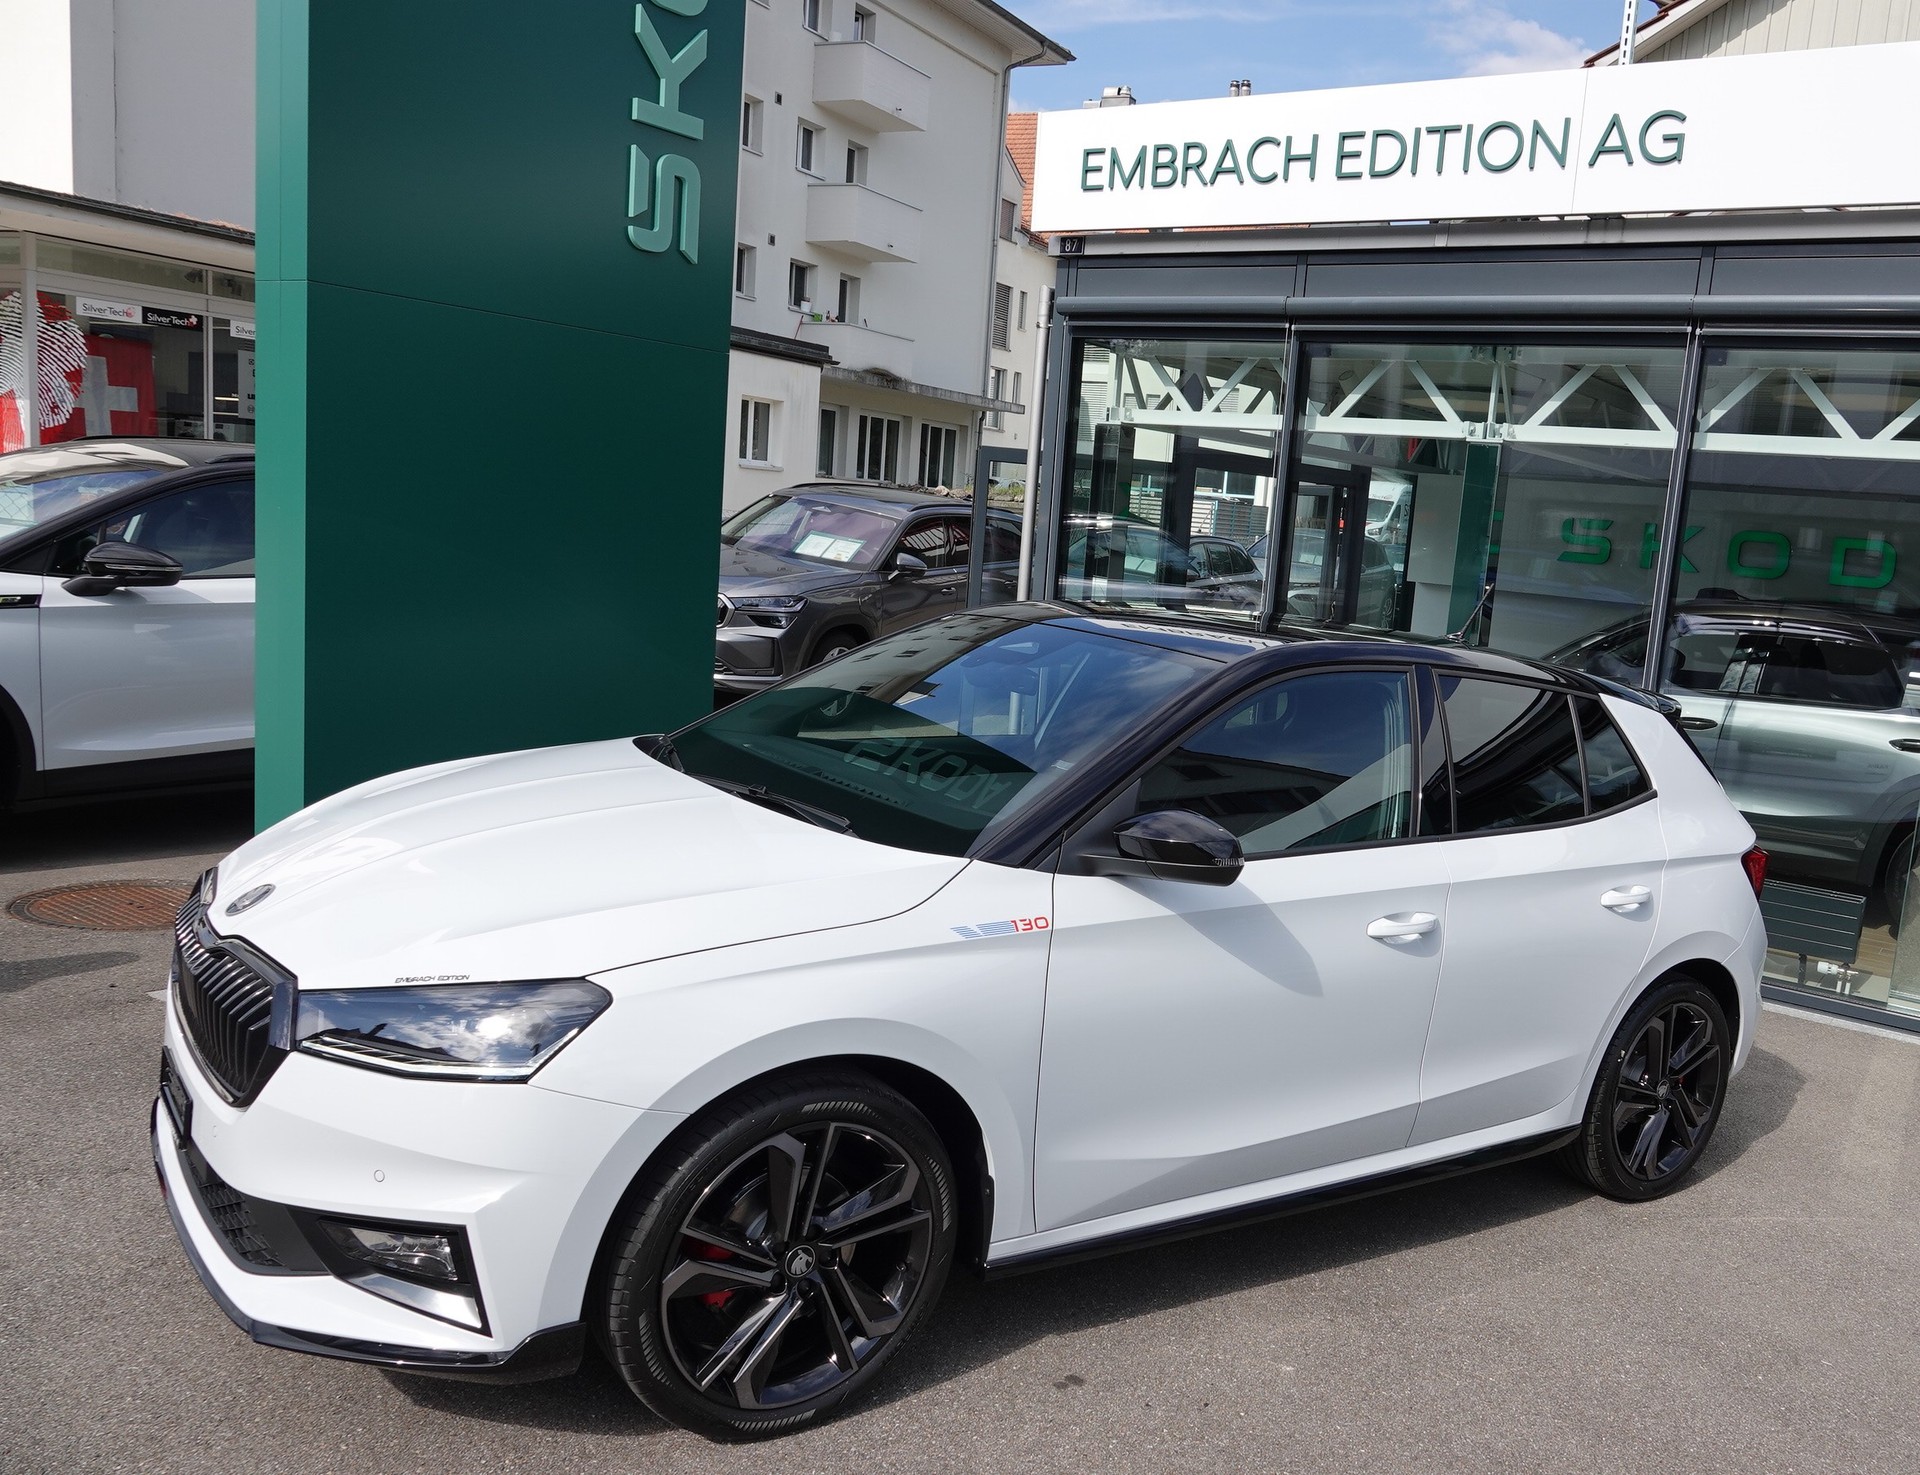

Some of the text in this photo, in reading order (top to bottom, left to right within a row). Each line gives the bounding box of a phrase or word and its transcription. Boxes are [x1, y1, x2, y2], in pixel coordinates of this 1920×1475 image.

[627, 0, 709, 264] SK
[1080, 108, 1688, 192] EMBRACH EDITION AG
[1064, 238, 1079, 252] 87
[1010, 916, 1050, 933] 130
